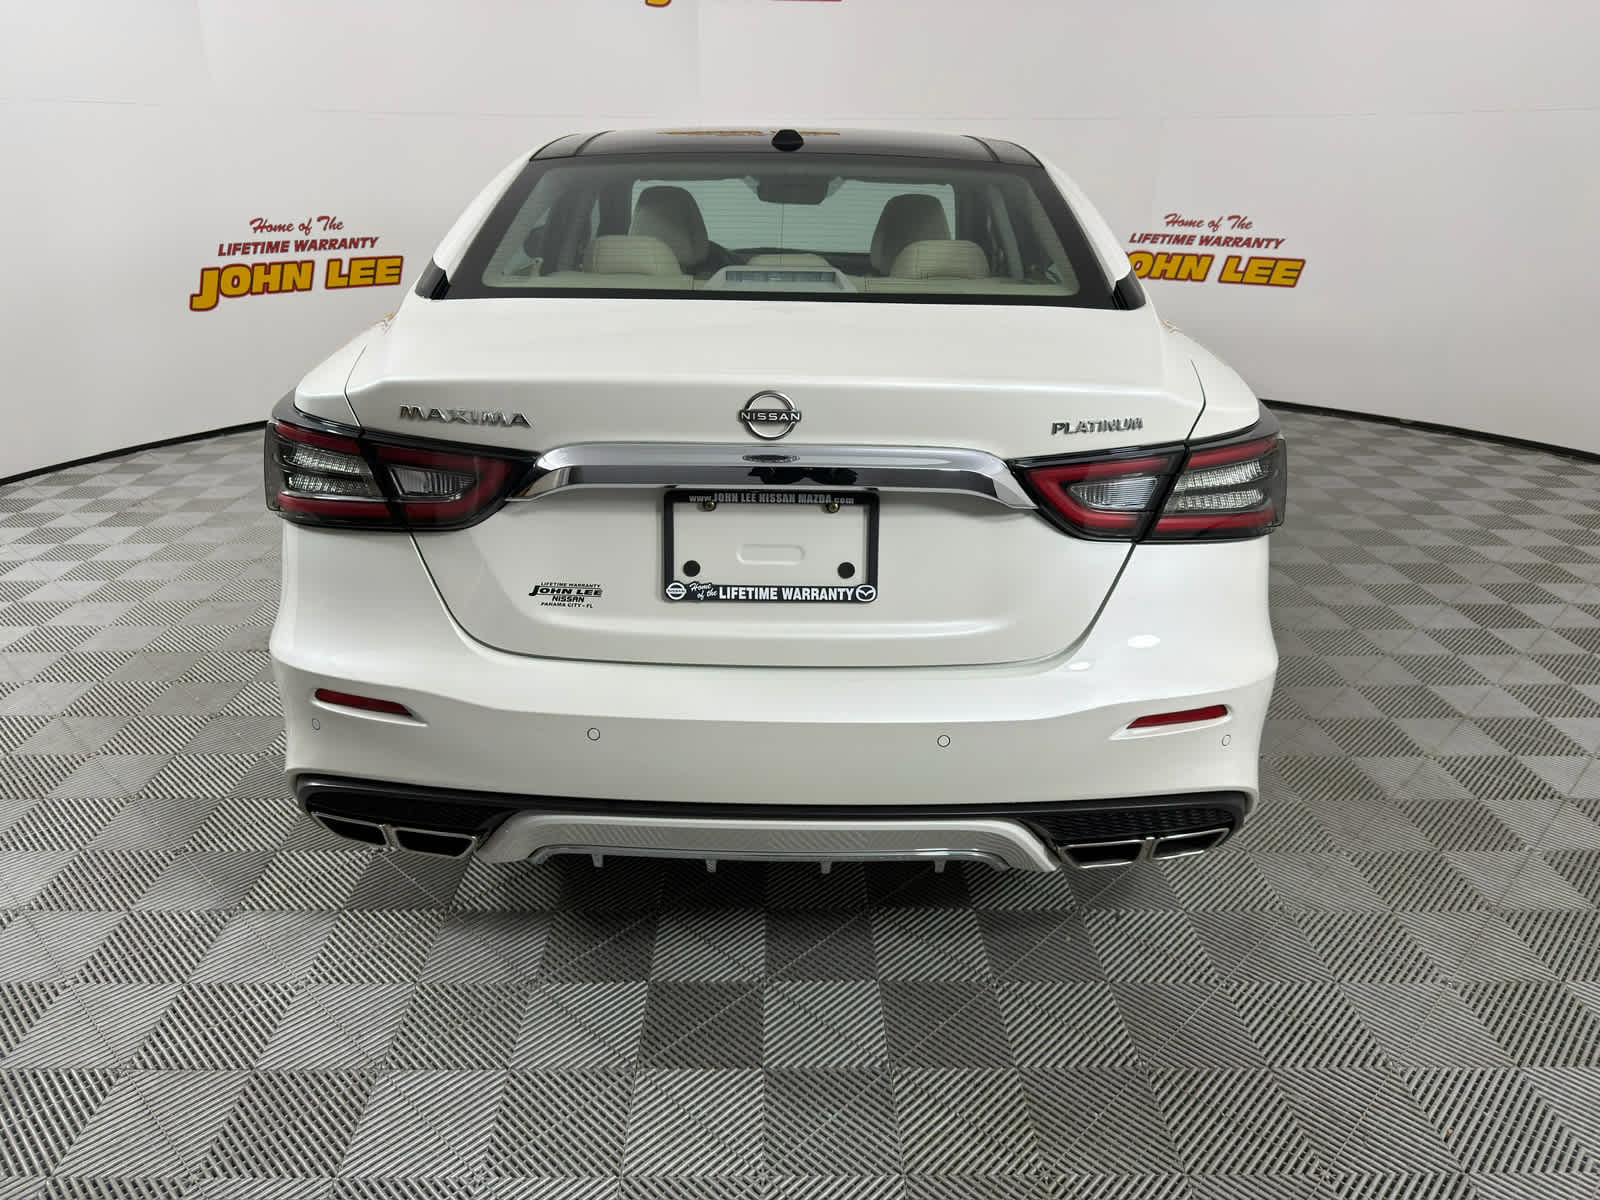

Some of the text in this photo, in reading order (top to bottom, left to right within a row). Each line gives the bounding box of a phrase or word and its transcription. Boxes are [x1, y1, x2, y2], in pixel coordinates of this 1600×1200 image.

[249, 215, 344, 236] Home of The
[1164, 213, 1253, 232] Home of The
[218, 236, 379, 256] LIFETIME WARRANTY
[1128, 233, 1286, 249] LIFETIME WARRANTY
[1126, 250, 1306, 288] OHN LEE
[190, 255, 404, 312] JOHN LEE
[399, 404, 532, 428] MAXIMA
[741, 412, 801, 421] NISSAN
[1051, 418, 1143, 435] PLATINUM
[740, 492, 757, 503] LEE
[758, 492, 796, 504] NISSAN
[528, 585, 602, 596] JOHN LEE
[689, 583, 712, 592] Home
[706, 588, 718, 597] the
[719, 586, 854, 601] LIFETIME WARRANTY
[552, 595, 585, 603] NISSAN
